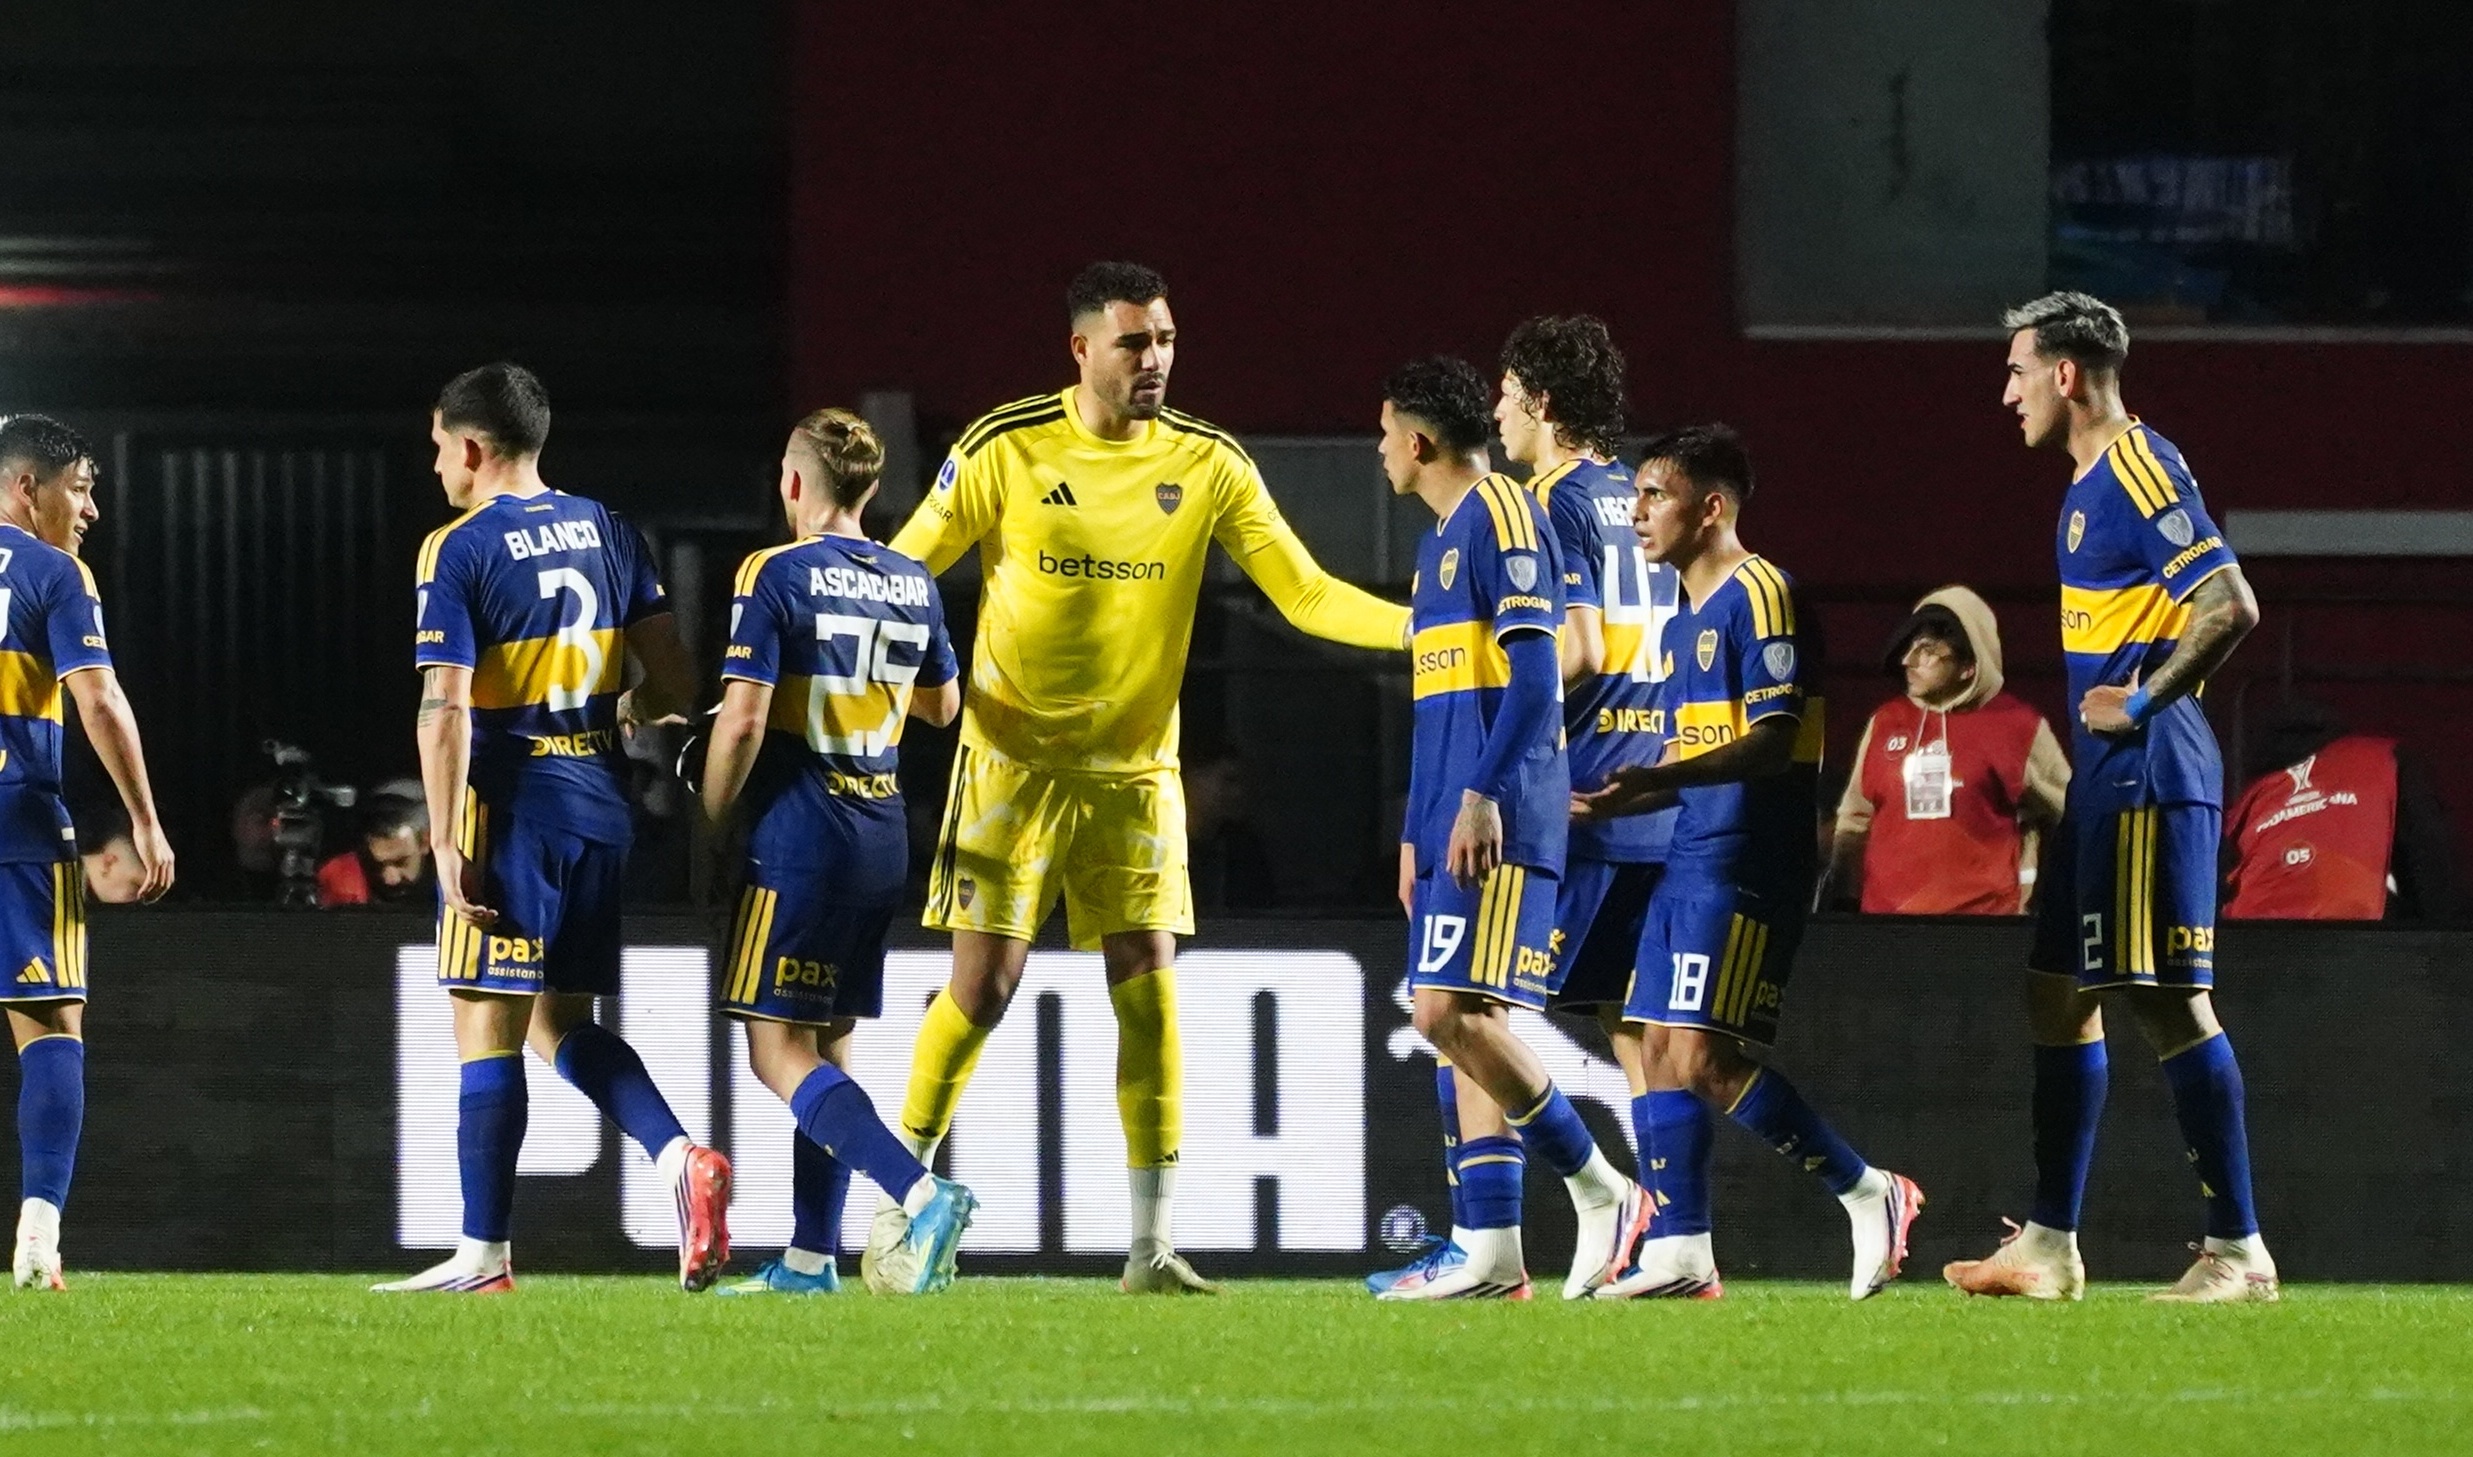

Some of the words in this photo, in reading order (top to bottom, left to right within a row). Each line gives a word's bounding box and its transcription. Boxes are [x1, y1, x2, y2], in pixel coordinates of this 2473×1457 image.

[504, 520, 601, 561] BLANCO
[2162, 536, 2223, 579] CETROGAR
[1038, 550, 1165, 580] betsson
[537, 567, 602, 713] 3
[806, 613, 930, 758] 25
[1745, 683, 1802, 704] CETROG
[1887, 736, 1908, 752] 03
[2285, 848, 2311, 866] 05
[488, 934, 544, 965] pax
[1417, 914, 1467, 973] 19
[2082, 912, 2103, 971] 2
[775, 956, 839, 988] pax
[1668, 952, 1711, 1011] 18
